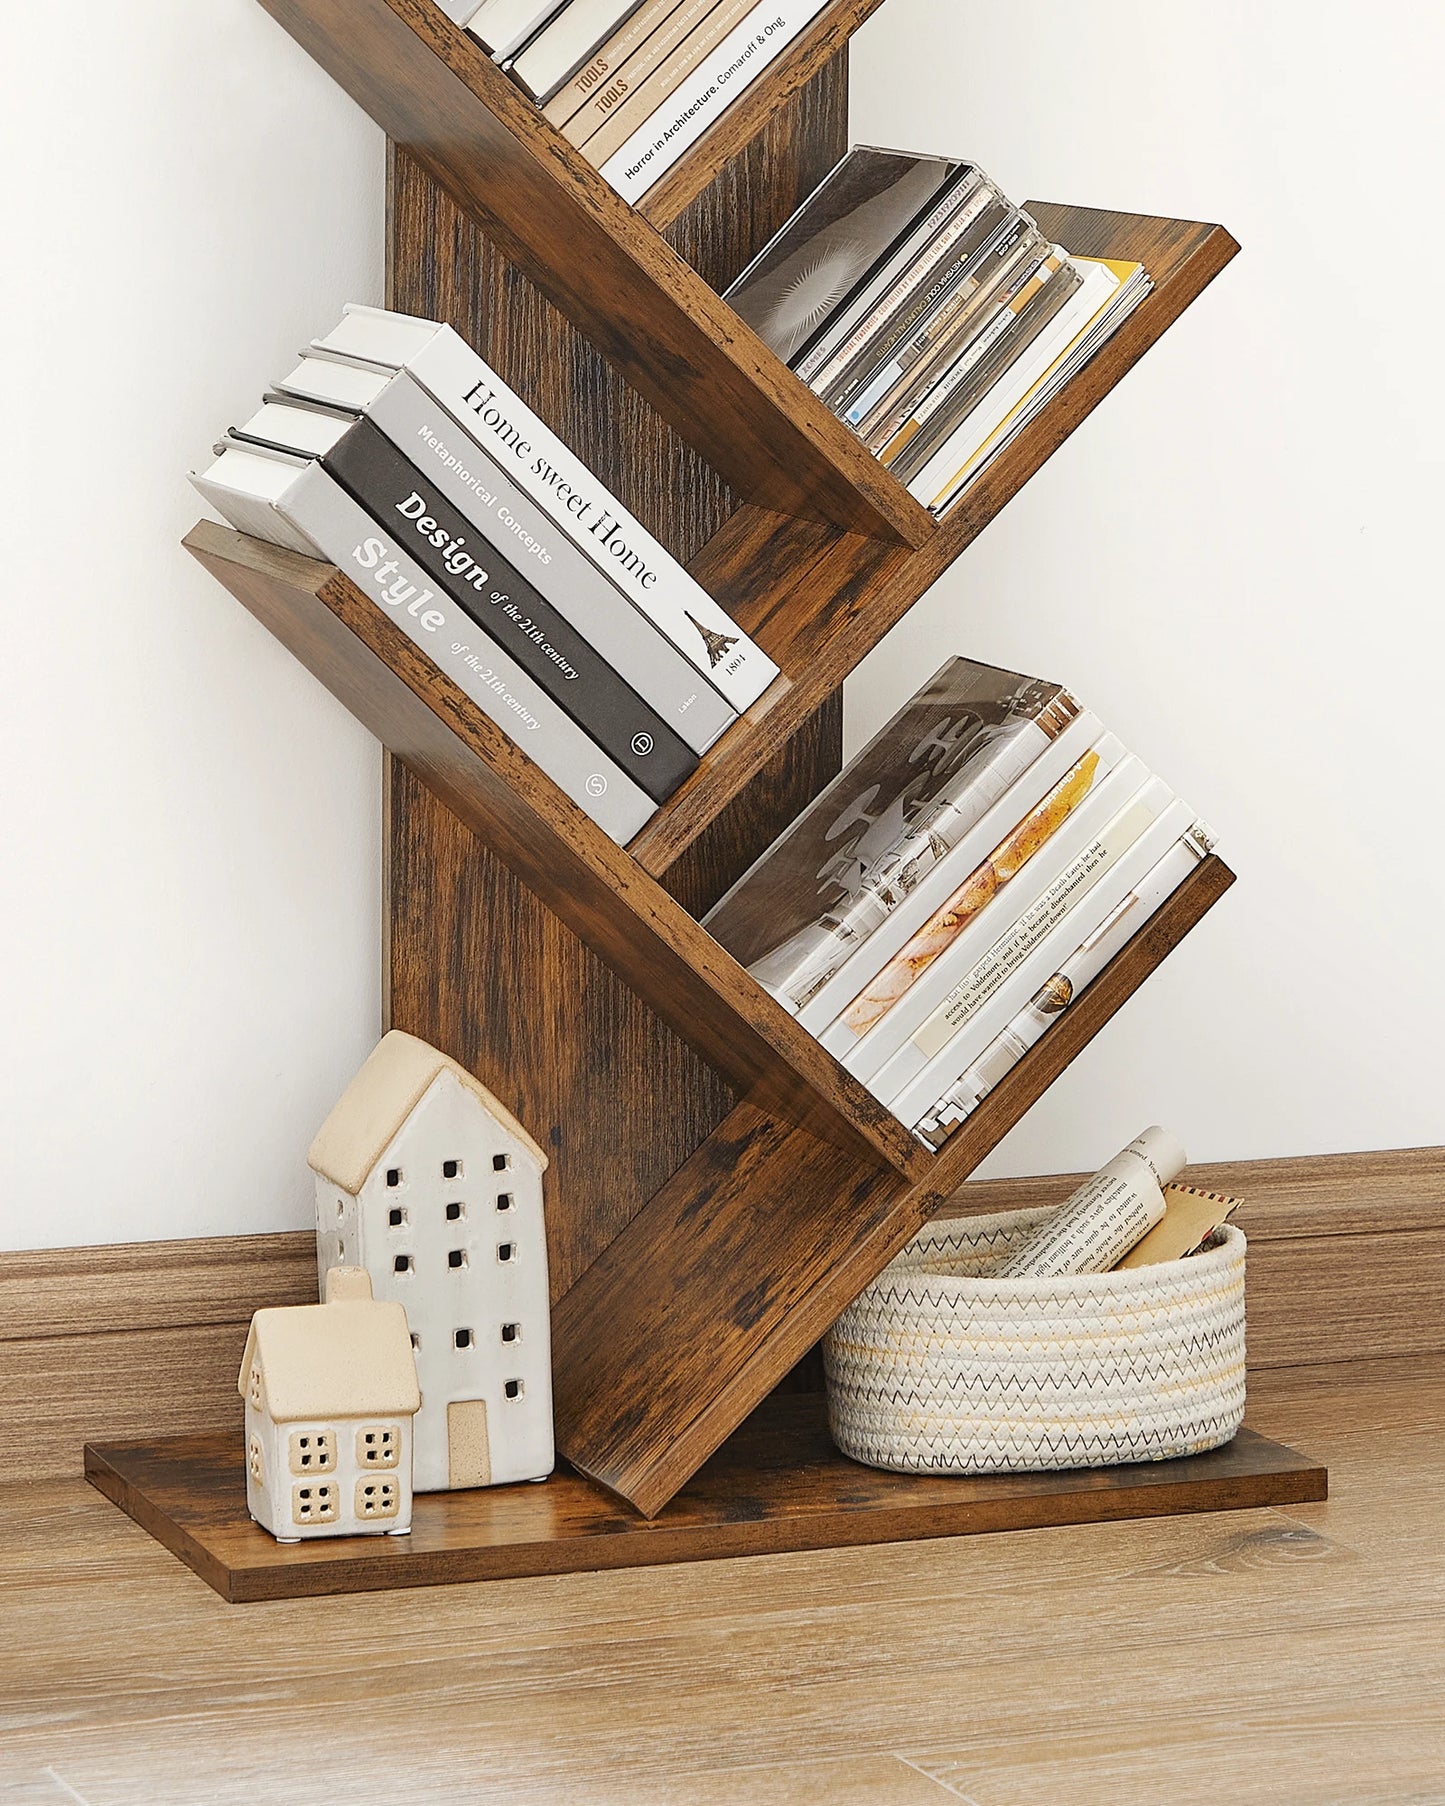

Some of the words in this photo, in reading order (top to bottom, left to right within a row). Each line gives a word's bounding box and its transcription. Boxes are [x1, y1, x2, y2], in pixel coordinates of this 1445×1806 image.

[574, 58, 608, 93] TOOLS
[594, 78, 628, 114] TOOLS
[624, 148, 654, 180] Horror
[652, 140, 665, 151] in
[663, 86, 719, 142] Architecture.
[716, 41, 757, 85] Comaroff
[755, 34, 766, 45] &
[763, 16, 786, 36] Ong
[936, 258, 963, 287] KEYSHIA
[922, 282, 942, 303] COLE
[903, 298, 928, 326] CALLING
[894, 321, 908, 336] ALL
[874, 332, 899, 358] HEARTS
[417, 424, 498, 507] Metaphorical
[497, 506, 552, 564] Concepts
[461, 379, 531, 458] Home
[530, 457, 591, 520] sweet
[587, 510, 656, 589] Home
[395, 491, 488, 591] Design
[490, 591, 509, 604] of
[502, 603, 522, 621] the
[517, 618, 545, 644] 21th
[540, 643, 579, 679] century
[351, 537, 445, 632] Style
[450, 642, 470, 655] of
[463, 654, 483, 672] the
[479, 668, 506, 695] 21th
[502, 693, 541, 730] century
[676, 691, 698, 714] Lakon
[634, 736, 650, 752] D
[591, 777, 603, 794] S
[970, 954, 994, 979] gasped
[1023, 909, 1035, 921] he
[1032, 897, 1047, 913] was
[1047, 875, 1068, 896] Death
[1079, 850, 1091, 863] he
[1086, 839, 1102, 855] had
[942, 999, 964, 1022] access
[961, 990, 972, 1001] to
[968, 958, 1002, 994] Voldemort,
[998, 945, 1014, 961] and
[1010, 938, 1021, 948] if
[1017, 929, 1029, 942] he
[1025, 907, 1050, 933] became
[1047, 869, 1086, 911] disenchanted
[1082, 855, 1099, 873] then
[1096, 846, 1108, 859] he
[948, 1005, 970, 1028] would
[965, 991, 983, 1010] have
[979, 972, 1002, 996] wanted
[998, 964, 1009, 976] to
[1004, 948, 1025, 970] bring
[1019, 919, 1051, 953] Voldemort
[1098, 1175, 1118, 1194] never
[1102, 1180, 1130, 1208] matches
[1075, 1190, 1103, 1218] formerly
[1087, 1202, 1106, 1222] gave
[1114, 1190, 1140, 1216] wanted
[1122, 1201, 1146, 1226] rubbed
[1064, 1217, 1076, 1230] had
[1074, 1217, 1093, 1237] such
[1097, 1219, 1111, 1233] be
[1106, 1212, 1118, 1223] to
[1122, 1212, 1151, 1241] delicious
[1054, 1225, 1069, 1239] the
[1081, 1227, 1102, 1248] quite
[1111, 1223, 1125, 1237] the
[1020, 1234, 1059, 1273] grandmother
[1046, 1237, 1074, 1265] brilliant
[1069, 1244, 1086, 1261] sure
[1093, 1234, 1114, 1255] whole
[1107, 1238, 1125, 1256] roast
[999, 1263, 1018, 1281] both
[1031, 1259, 1052, 1279] light
[1060, 1258, 1074, 1272] of
[1072, 1252, 1097, 1276] bundle
